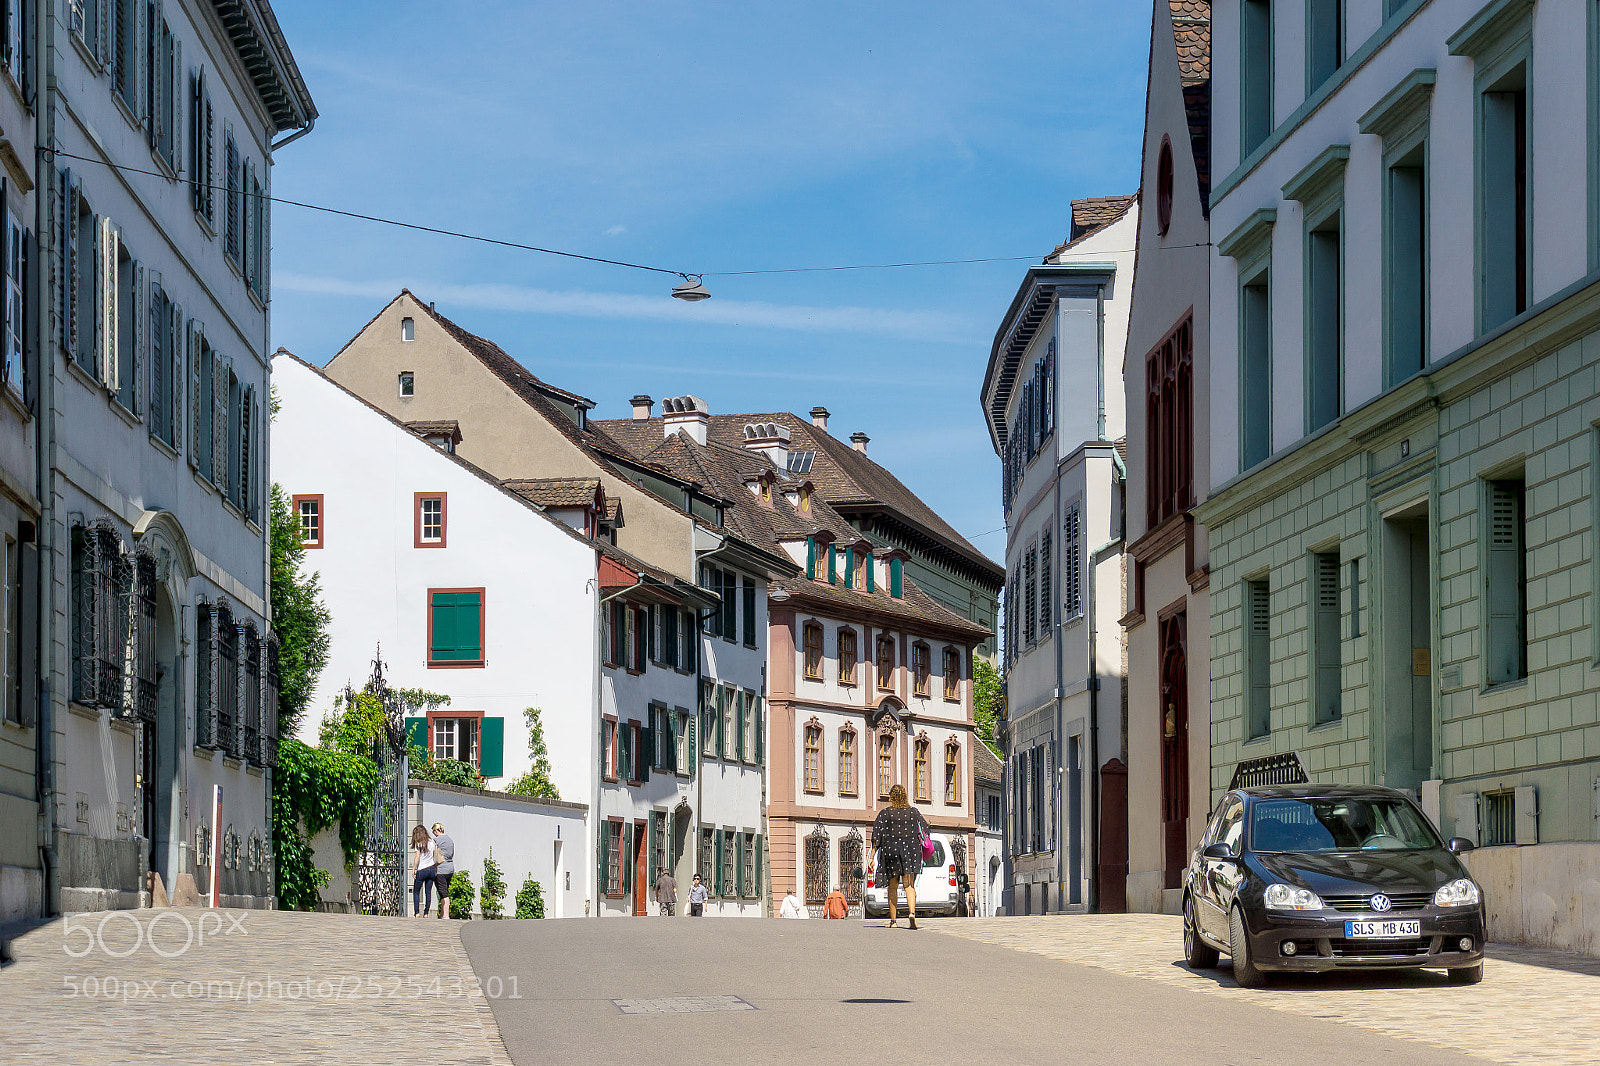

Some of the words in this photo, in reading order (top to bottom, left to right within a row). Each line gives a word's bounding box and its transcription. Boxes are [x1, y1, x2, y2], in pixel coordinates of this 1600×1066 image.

[1354, 923, 1374, 935] SLS
[1382, 922, 1396, 934] MB
[1400, 922, 1419, 934] 430
